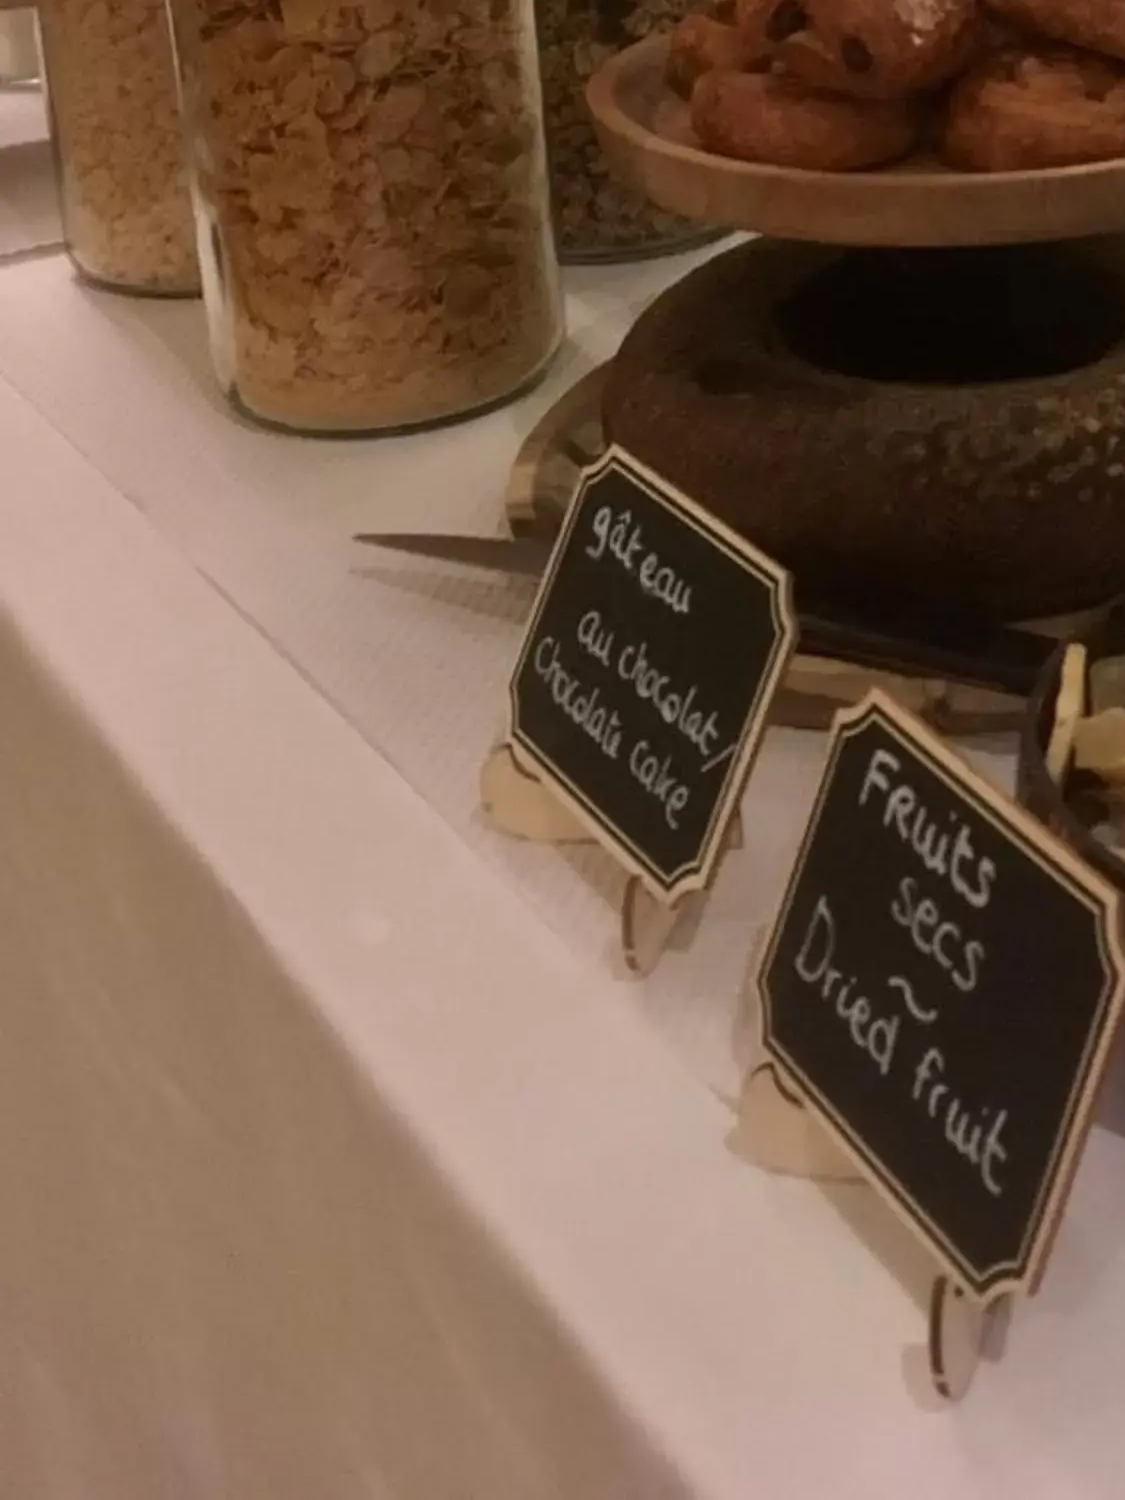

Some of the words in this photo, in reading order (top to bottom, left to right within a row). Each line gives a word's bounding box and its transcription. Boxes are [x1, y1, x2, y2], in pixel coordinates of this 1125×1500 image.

[577, 609, 616, 668] au
[891, 875, 985, 991] secs
[793, 895, 902, 1076] Dried
[911, 1046, 1010, 1197] fruit
